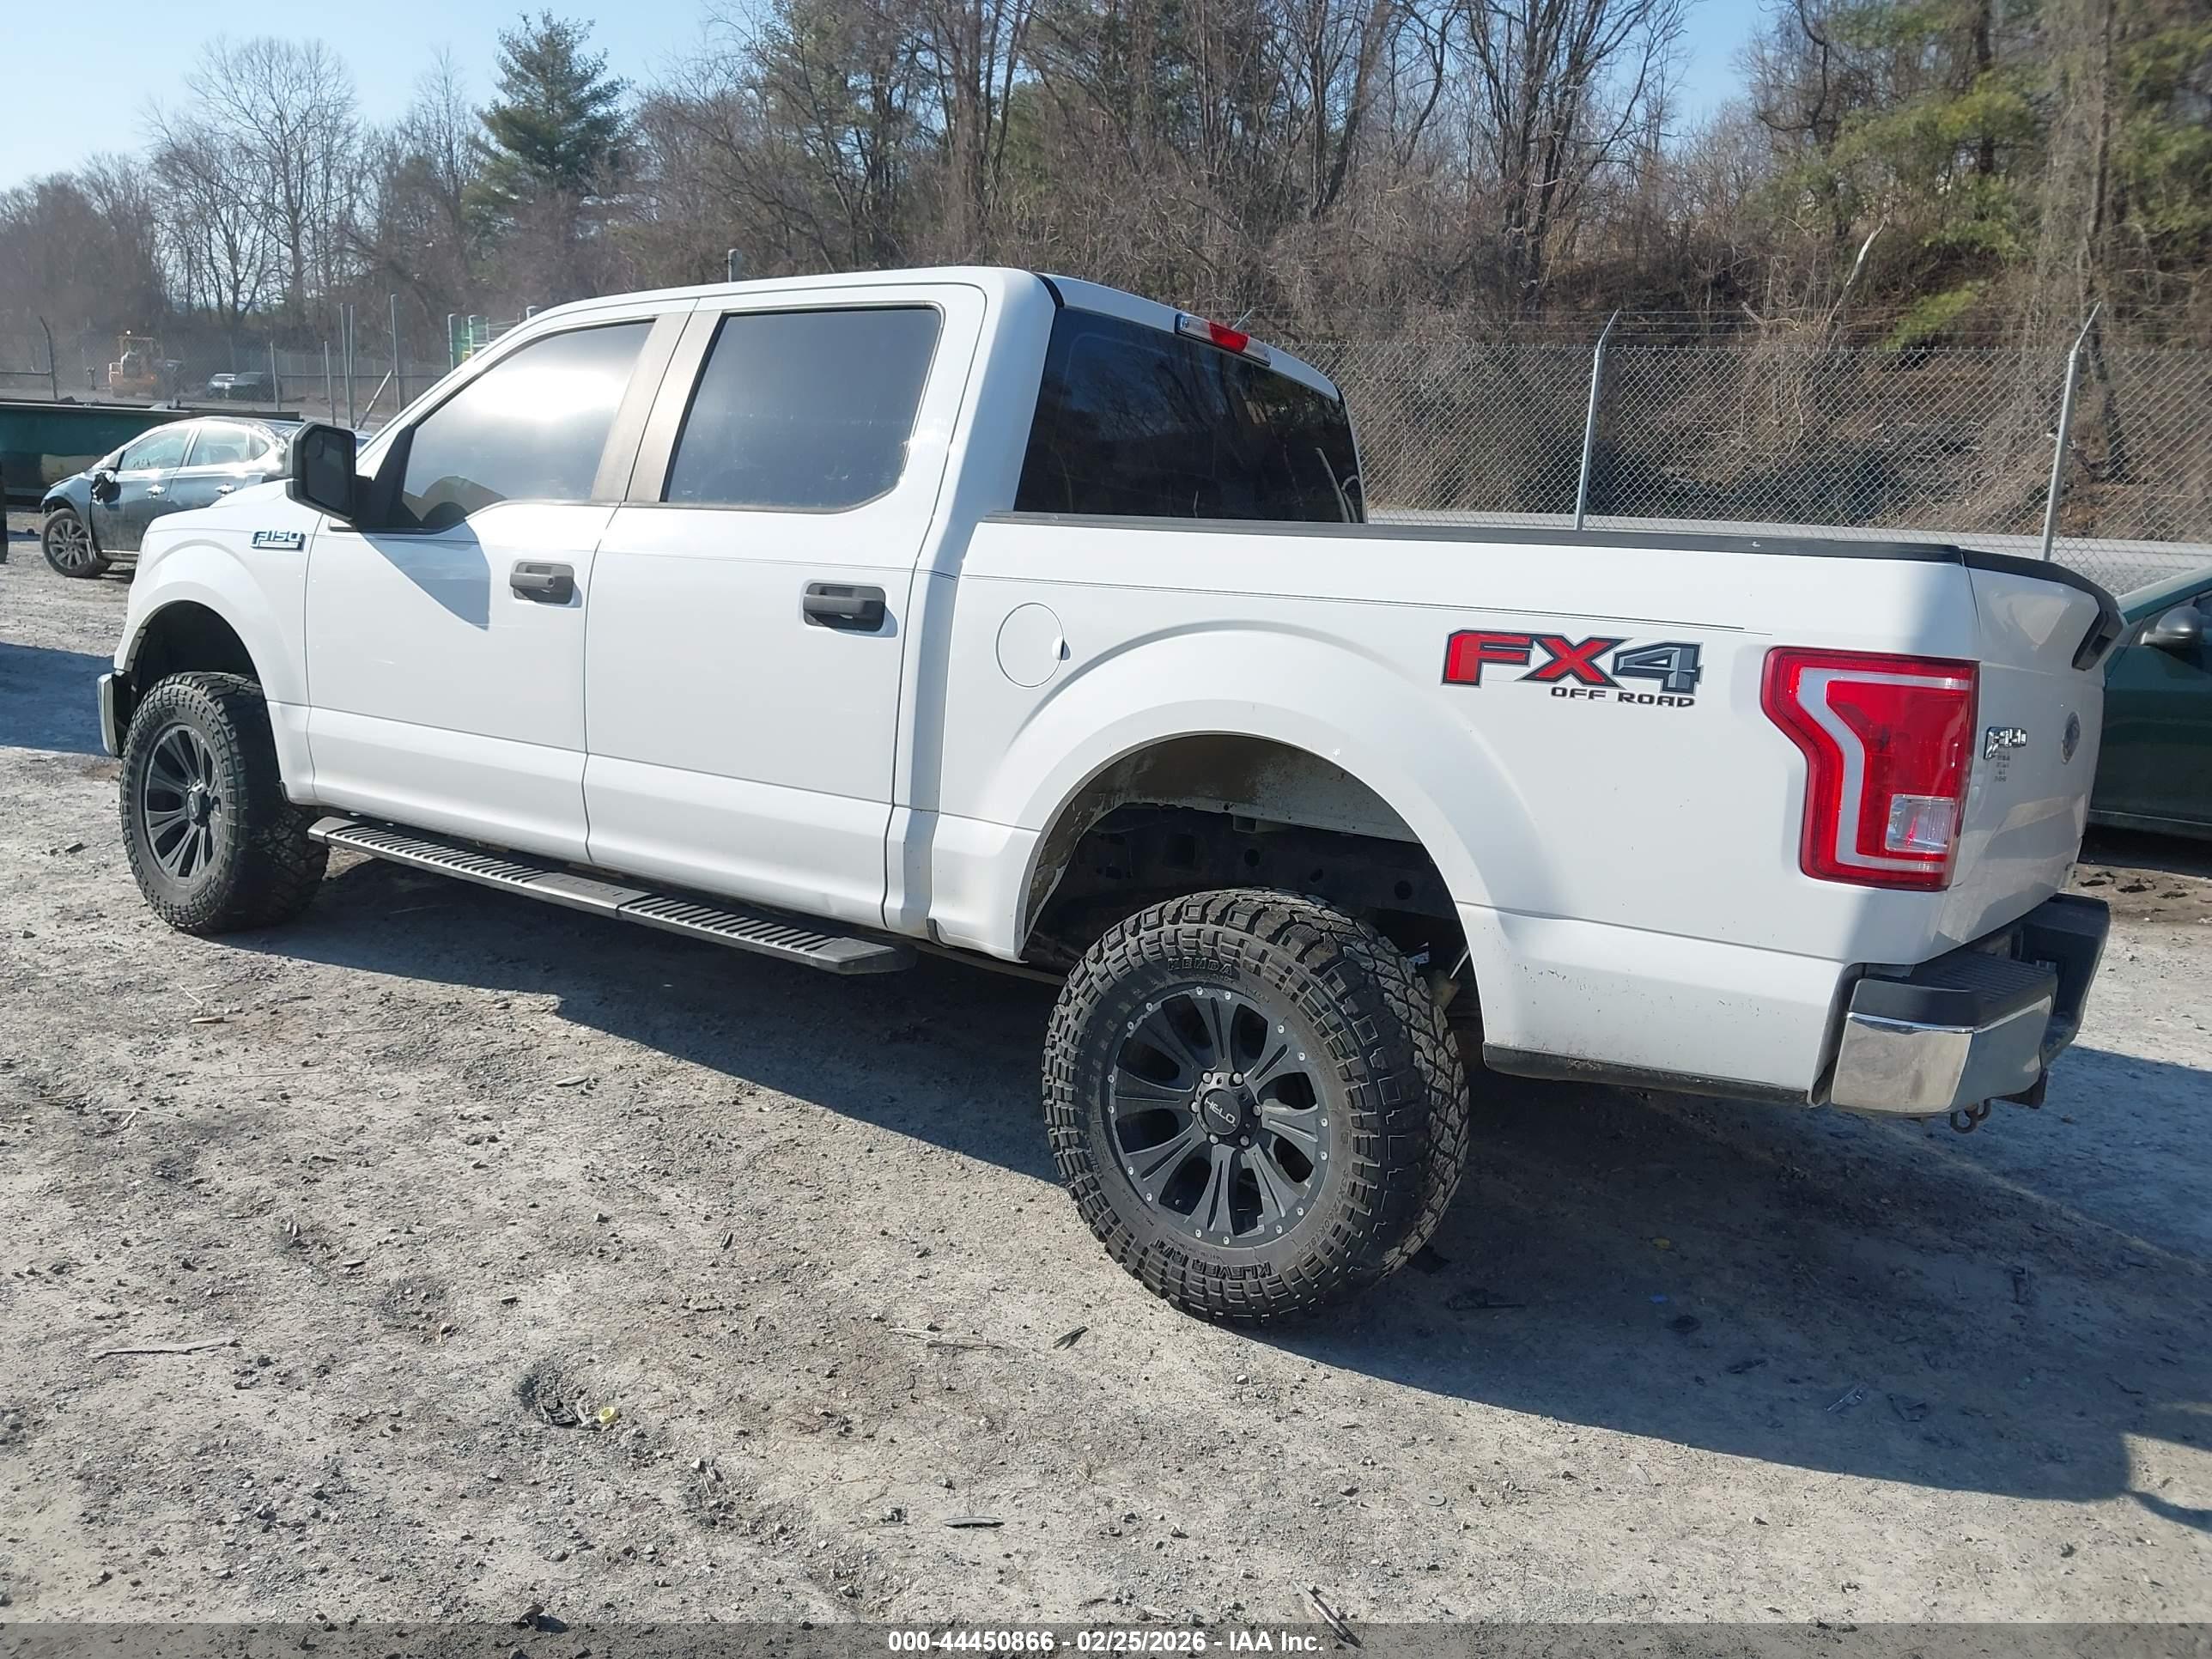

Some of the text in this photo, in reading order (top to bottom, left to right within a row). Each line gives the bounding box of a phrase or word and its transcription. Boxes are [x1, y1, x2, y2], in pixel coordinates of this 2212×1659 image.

[1441, 628, 1704, 694] FX4
[1551, 687, 1695, 708] OFF ROAD
[1167, 956, 1232, 975] KENDA
[1204, 1097, 1236, 1124] HELO
[1192, 1258, 1272, 1279] KLEVER
